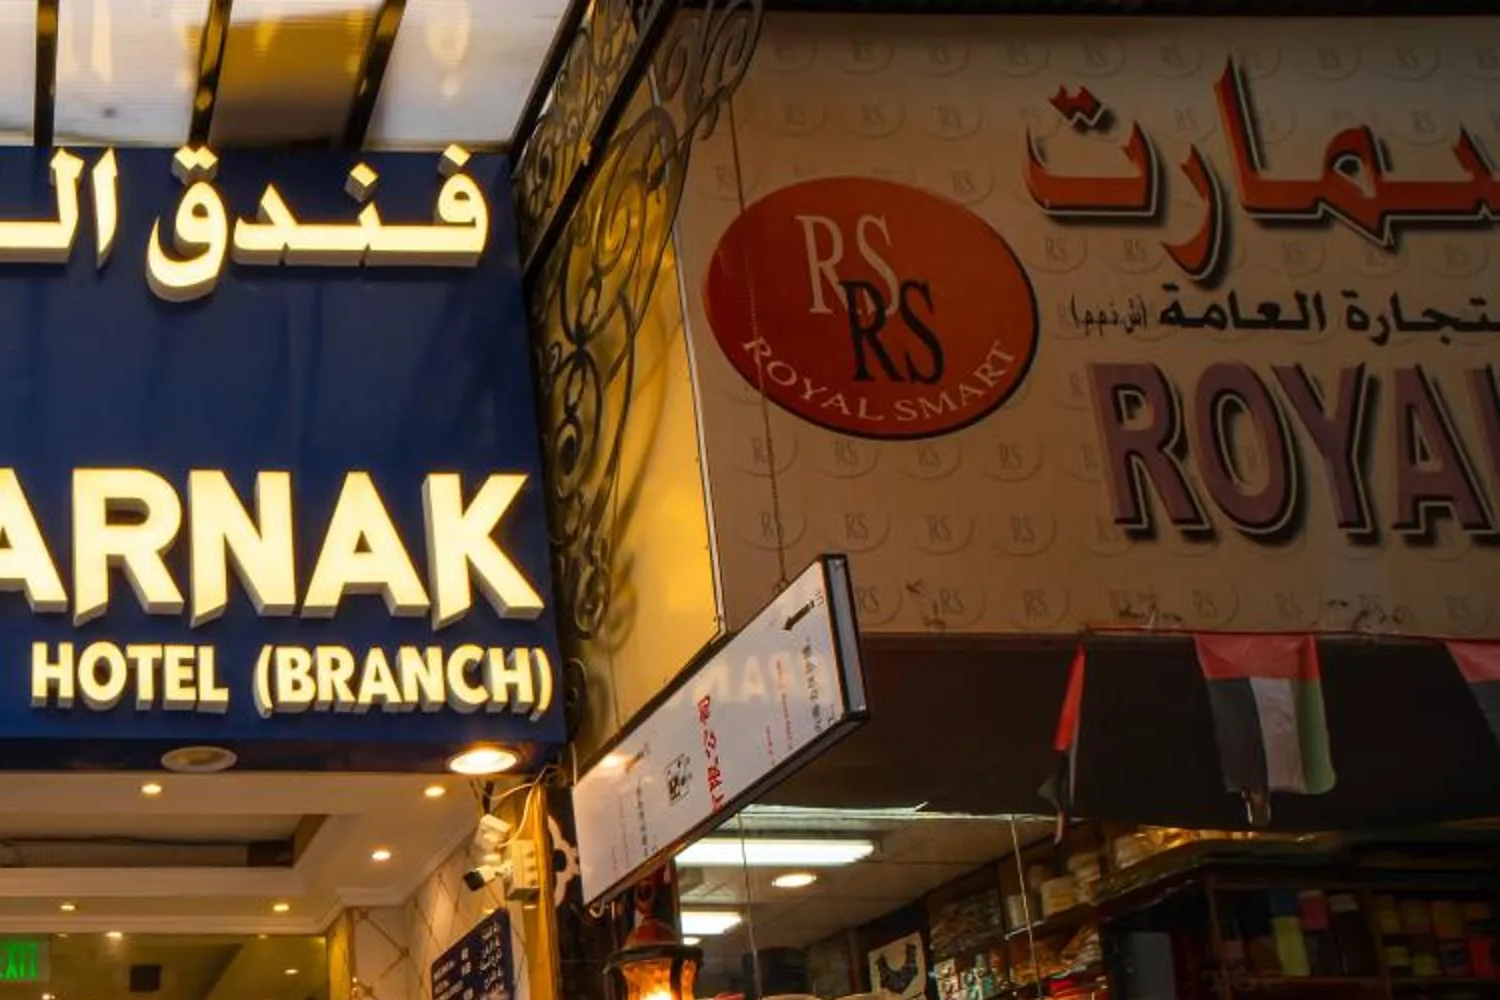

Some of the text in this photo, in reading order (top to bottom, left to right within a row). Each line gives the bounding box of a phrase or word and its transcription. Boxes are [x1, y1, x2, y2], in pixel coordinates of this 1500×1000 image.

[1023, 56, 1500, 284] مارت
[146, 144, 488, 300] فندق
[794, 214, 899, 316] RS
[838, 279, 945, 385] RS
[1159, 281, 1328, 332] العامة
[741, 336, 1017, 422] ROYAL SMART
[31, 641, 553, 722] HOTEL (BRANCH)
